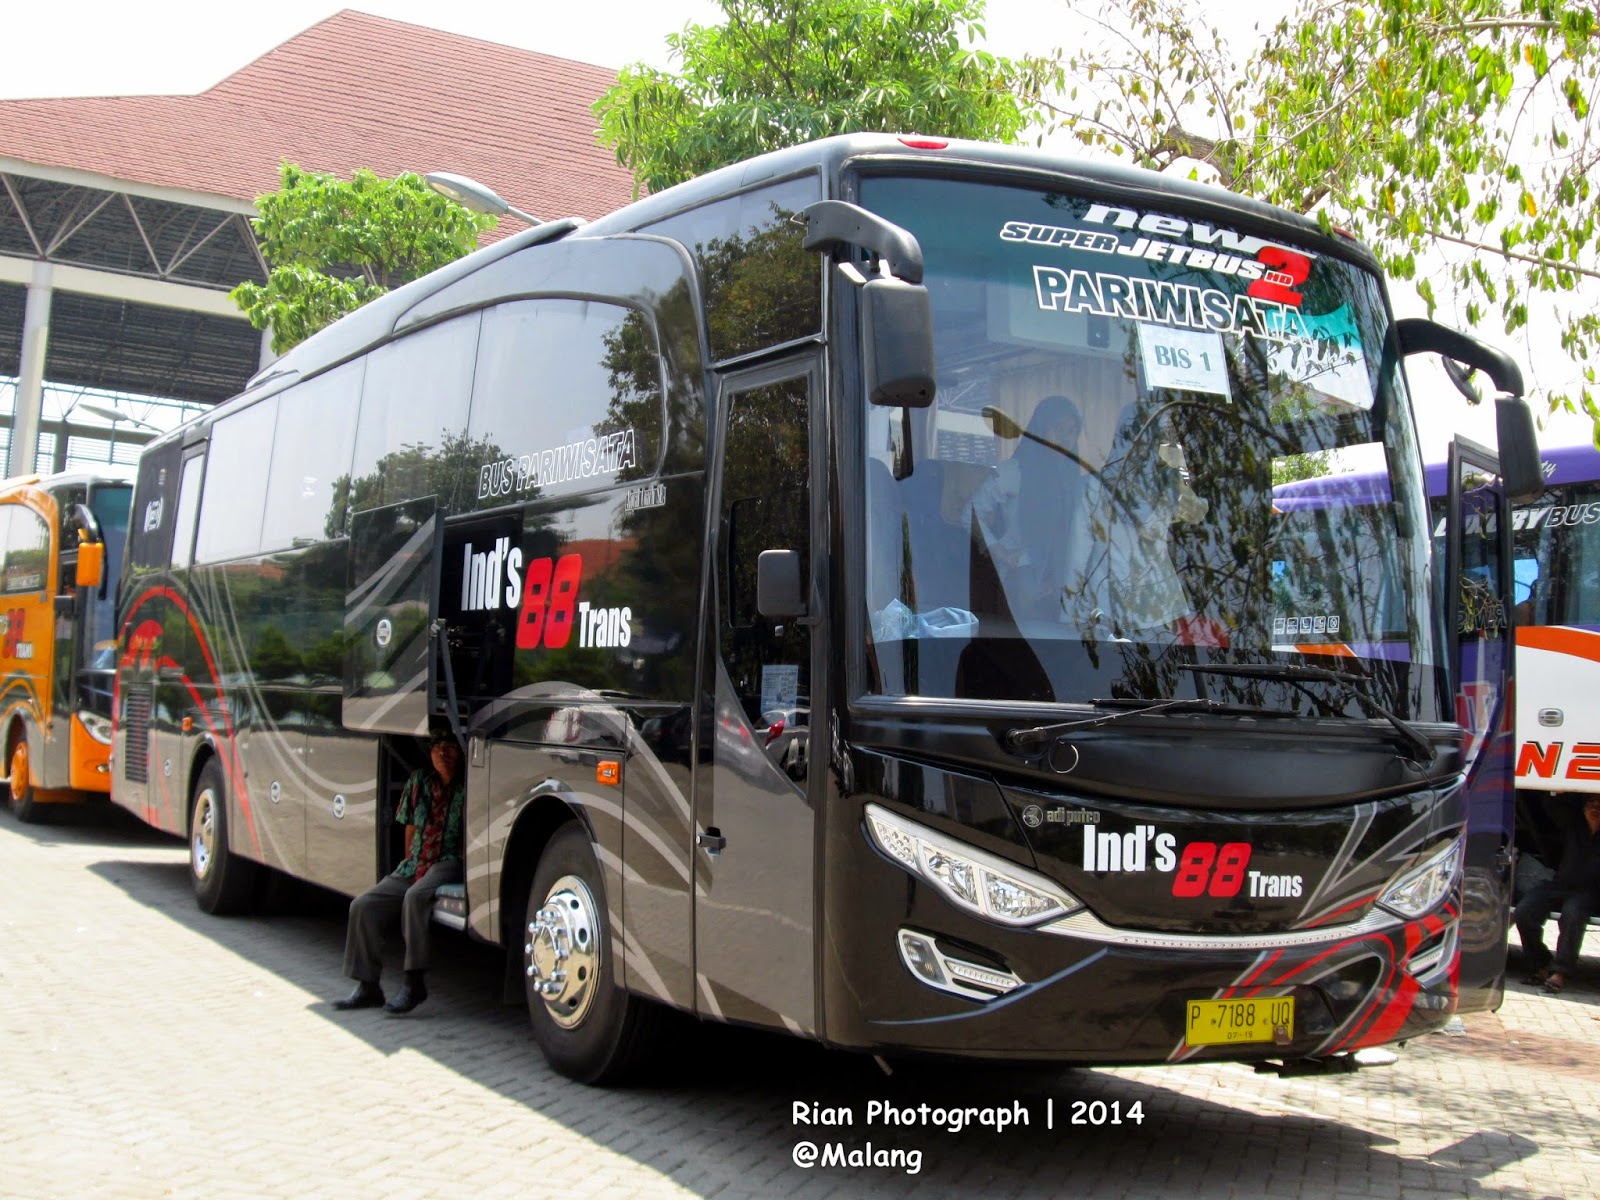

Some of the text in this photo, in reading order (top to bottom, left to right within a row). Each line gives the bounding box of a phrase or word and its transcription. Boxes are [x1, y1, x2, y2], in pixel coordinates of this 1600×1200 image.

[1000, 221, 1118, 254] SUPER
[1117, 236, 1266, 280] JETBUS
[1247, 245, 1313, 307] 2
[1082, 203, 1318, 260] new
[1032, 264, 1315, 350] PARIWISATA
[1155, 344, 1211, 371] BIS 1
[478, 429, 636, 499] BUS PARIWISATA
[461, 537, 632, 649] Ind's 88 Trans
[1083, 824, 1303, 897] Ind's 88 Trans
[1191, 1001, 1290, 1029] P 7188 UQ
